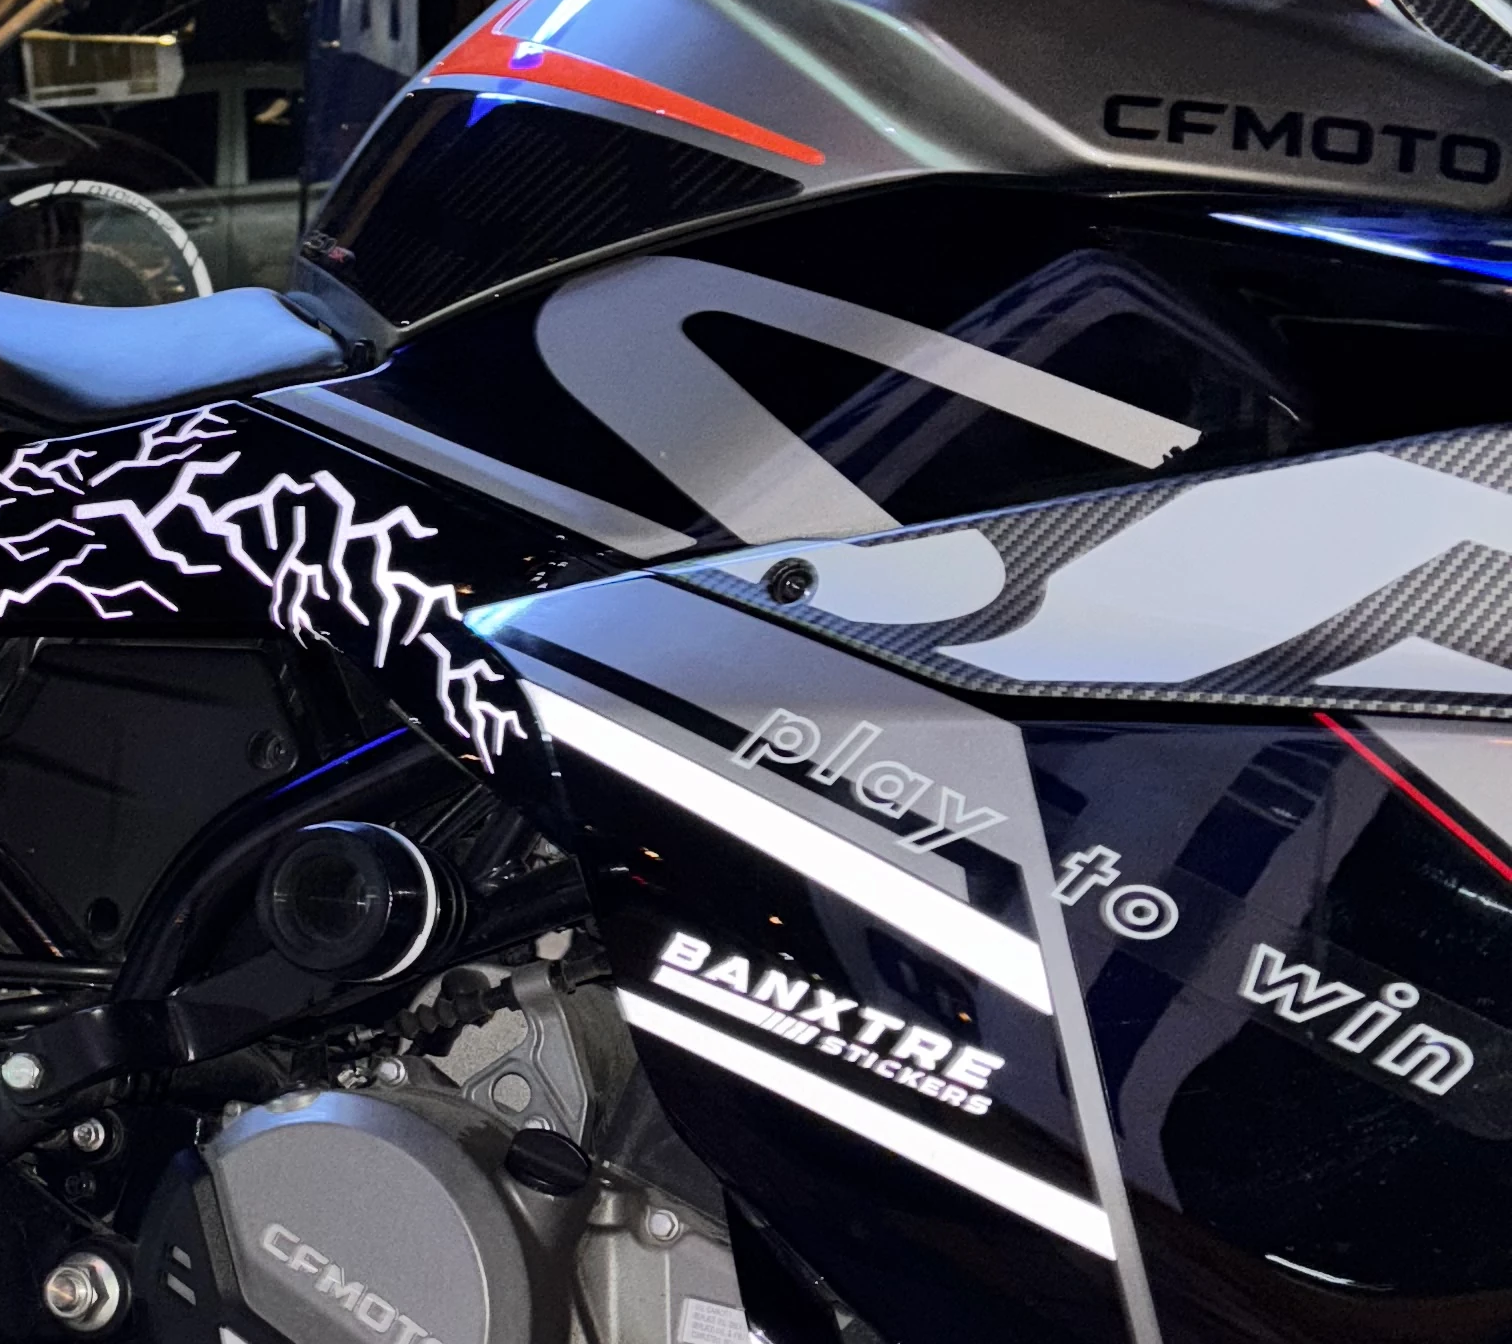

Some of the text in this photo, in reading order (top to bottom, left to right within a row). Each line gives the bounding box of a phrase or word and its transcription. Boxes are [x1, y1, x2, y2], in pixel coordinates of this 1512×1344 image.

[1102, 93, 1502, 185] CFMOTO
[731, 707, 1476, 1097] play to win
[660, 931, 1006, 1091] BANXTRE
[816, 1034, 994, 1116] STICKERS
